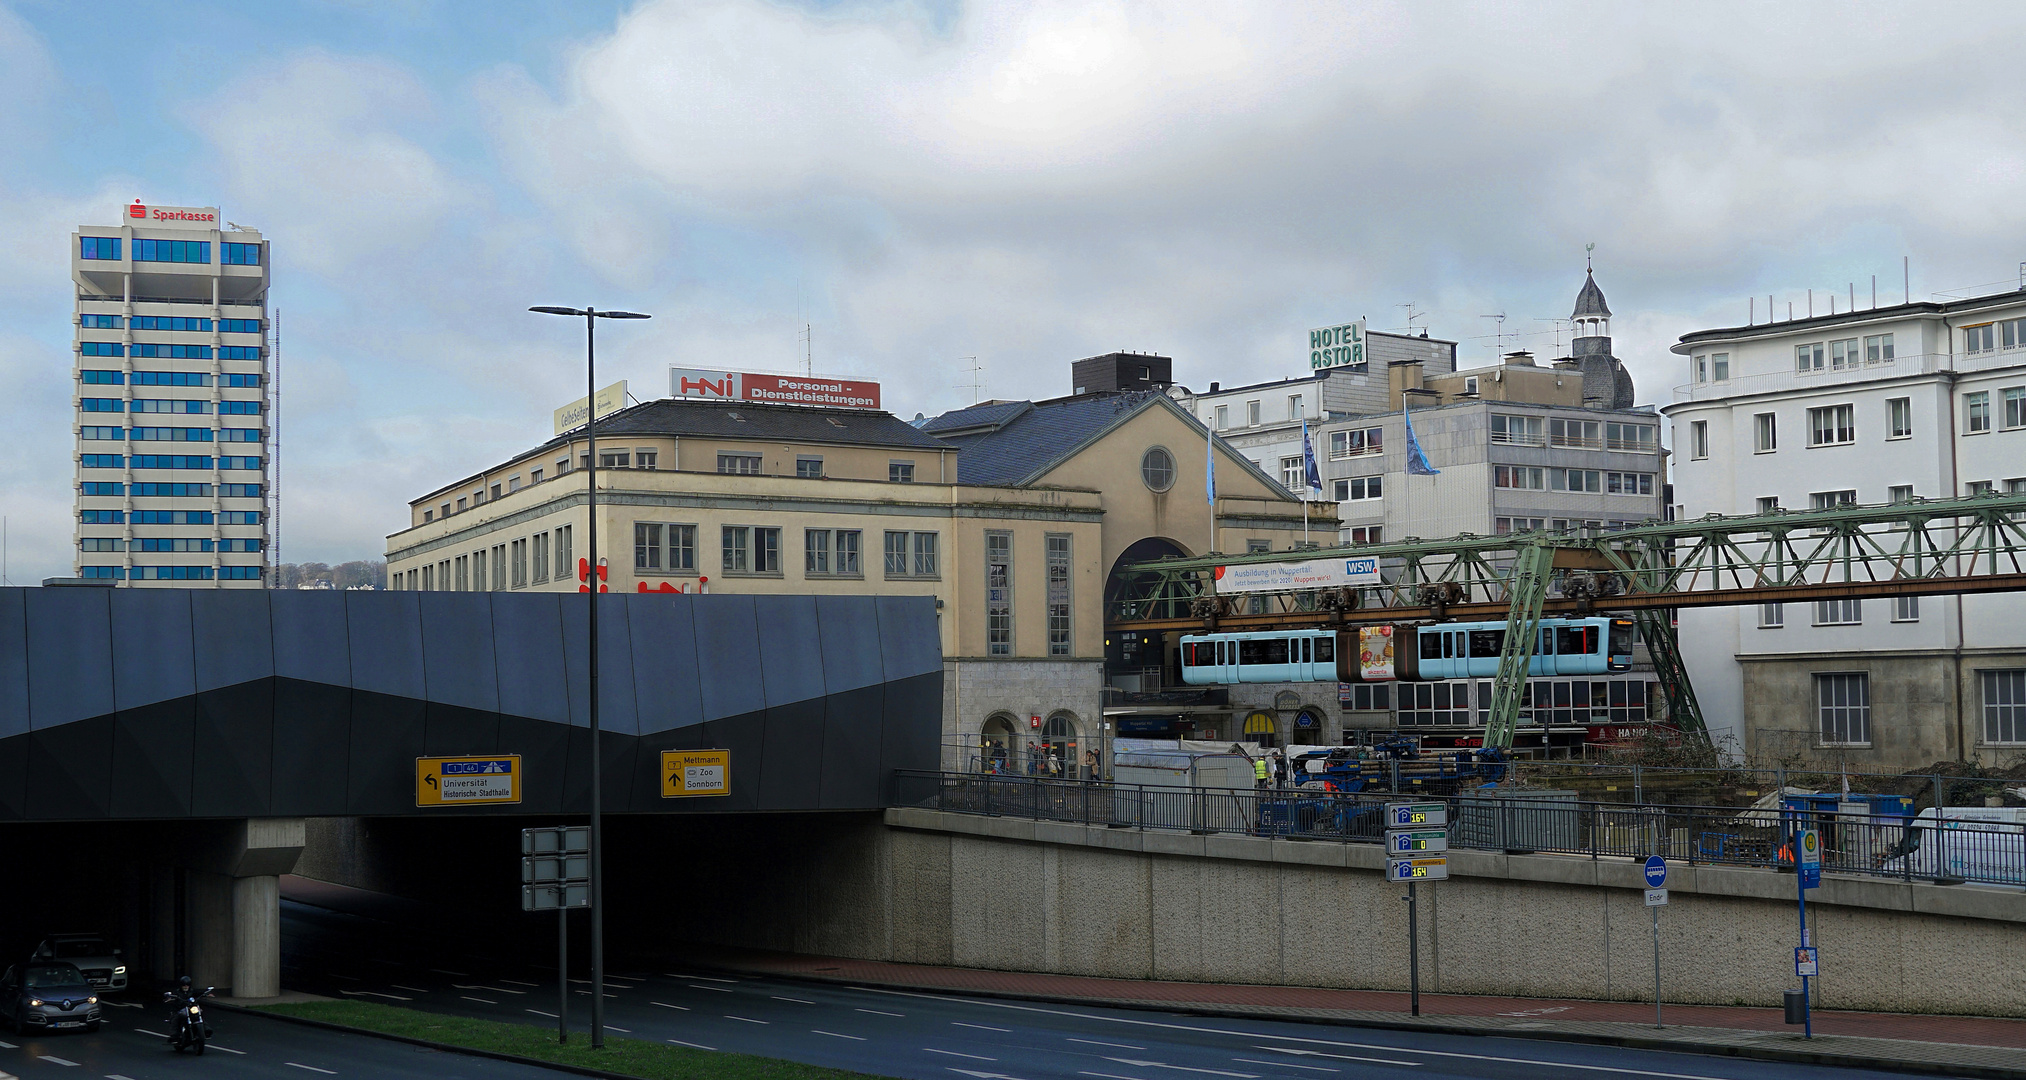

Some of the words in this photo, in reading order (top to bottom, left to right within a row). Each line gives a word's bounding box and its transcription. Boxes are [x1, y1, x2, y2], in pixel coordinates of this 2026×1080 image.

[153, 209, 214, 222] Sparkasse
[1311, 324, 1362, 349] HOTEL
[1311, 344, 1362, 368] ASTOR
[778, 379, 842, 393] Personal
[751, 388, 874, 406] Dienstleistungen
[1234, 568, 1269, 578] Ausbildung
[1278, 565, 1313, 576] Wuppertal:
[1234, 579, 1246, 587] Jetzt
[1247, 577, 1271, 586] bewerben
[1294, 576, 1316, 584] Wuppen
[1618, 728, 1630, 738] HA
[444, 779, 488, 788] Universität
[687, 780, 722, 788] Sonnborn
[444, 789, 477, 798] Historische
[479, 788, 510, 797] Stadthalle
[1411, 814, 1425, 823] 164
[1412, 868, 1427, 877] 164
